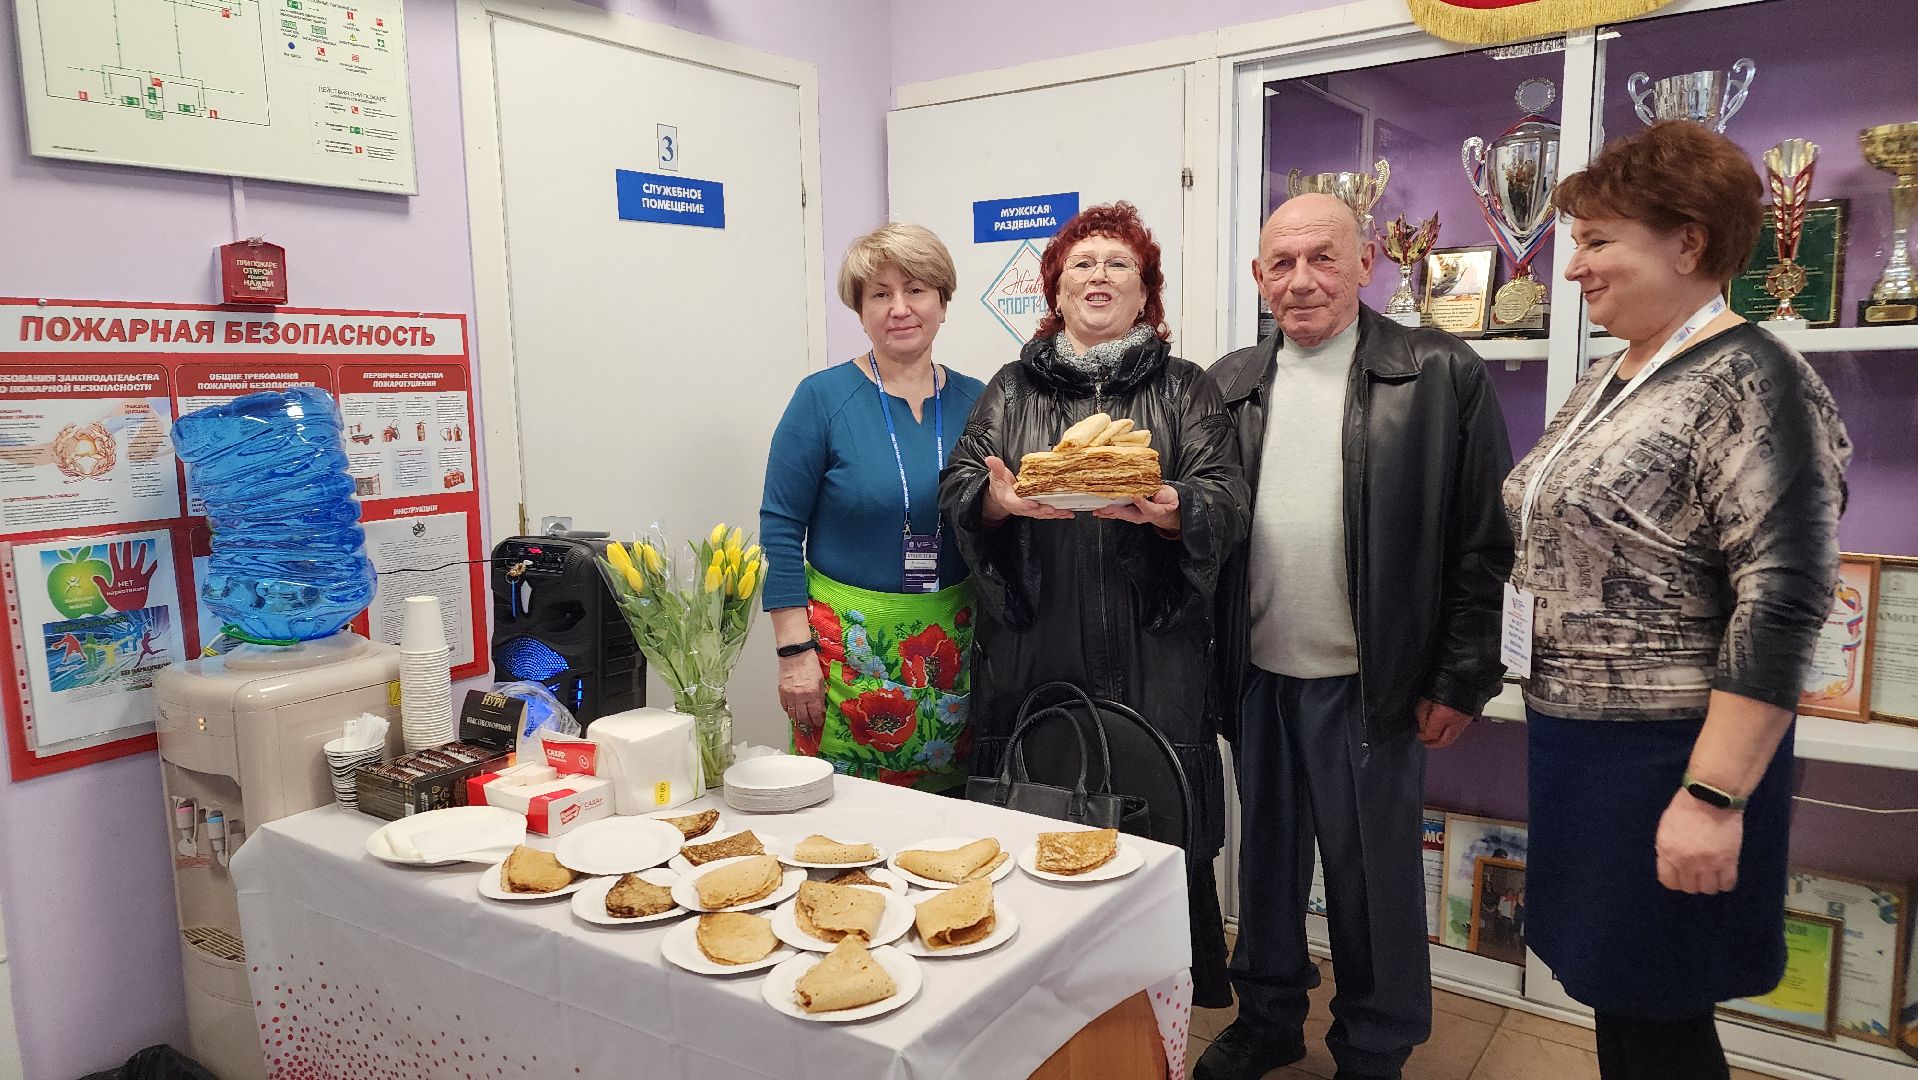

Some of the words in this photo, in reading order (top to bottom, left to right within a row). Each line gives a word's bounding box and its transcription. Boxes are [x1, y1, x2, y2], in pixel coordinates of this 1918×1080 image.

[661, 135, 673, 161] 3
[642, 182, 702, 199] СЛУЖЕБНОЕ
[641, 197, 704, 214] ПОМЕЩЕНИЕ
[1000, 204, 1050, 218] МУЖСКАЯ
[994, 216, 1057, 231] РАЗДЕВАЛКА
[250, 260, 278, 269] ПОЖАРЕ
[242, 267, 274, 276] ОТКРОЙ
[243, 279, 274, 288] НАЖМИ
[20, 315, 216, 344] ПОЖАРНАЯ
[223, 320, 437, 348] БЕЗОПАСНОСТЬ
[57, 373, 160, 382] ЗАКОНОДАТЕЛЬСТВА
[209, 372, 243, 380] ОБЩИЕ
[243, 372, 299, 381] ТРЕБОВАНИЯ
[9, 383, 71, 393] ПОЖАРНОЙ
[72, 383, 152, 392] БЕЗОПАСНОСТИ
[197, 380, 248, 390] ПОЖАРНОЙ
[249, 381, 315, 390] БЕЗОПАСНОСТИ
[373, 380, 436, 388] ПОЖАРОТУШЕНИЯ
[118, 579, 135, 587] НЕТ
[106, 585, 148, 597] наркотикам!
